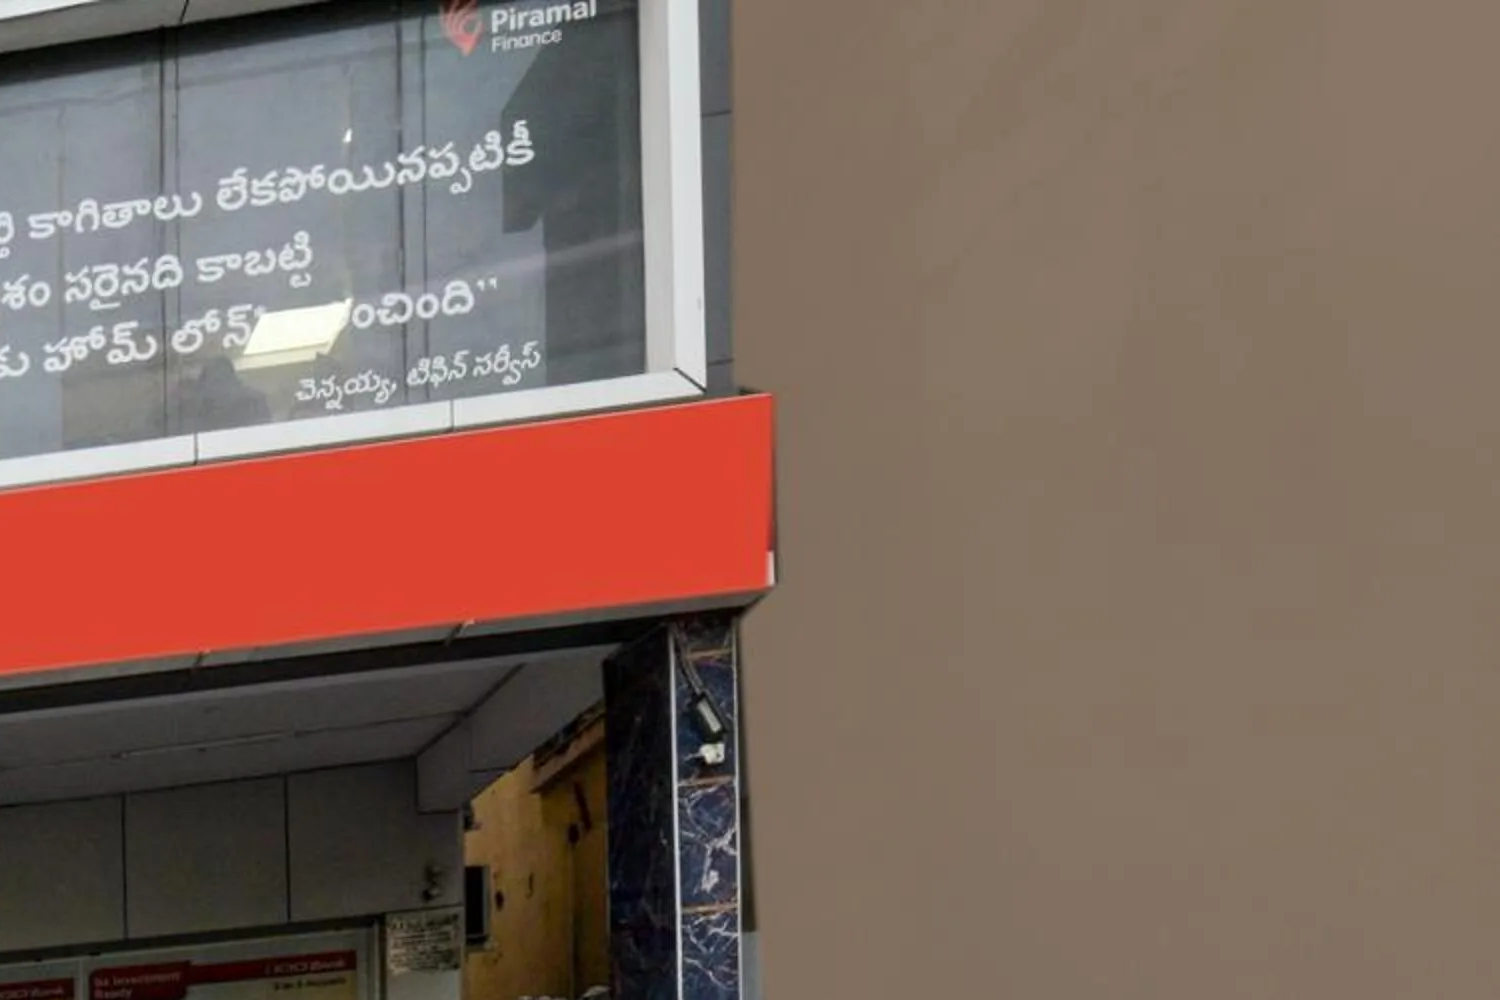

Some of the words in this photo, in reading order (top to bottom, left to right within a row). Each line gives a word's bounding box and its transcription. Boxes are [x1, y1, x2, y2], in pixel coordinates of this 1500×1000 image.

[491, 0, 597, 33] Piramal
[491, 29, 563, 52] Finance
[27, 191, 202, 239] కాగితాలు
[64, 254, 183, 310] సరైనది
[195, 230, 313, 289] కాబట్టి
[43, 321, 157, 373] హోమ్
